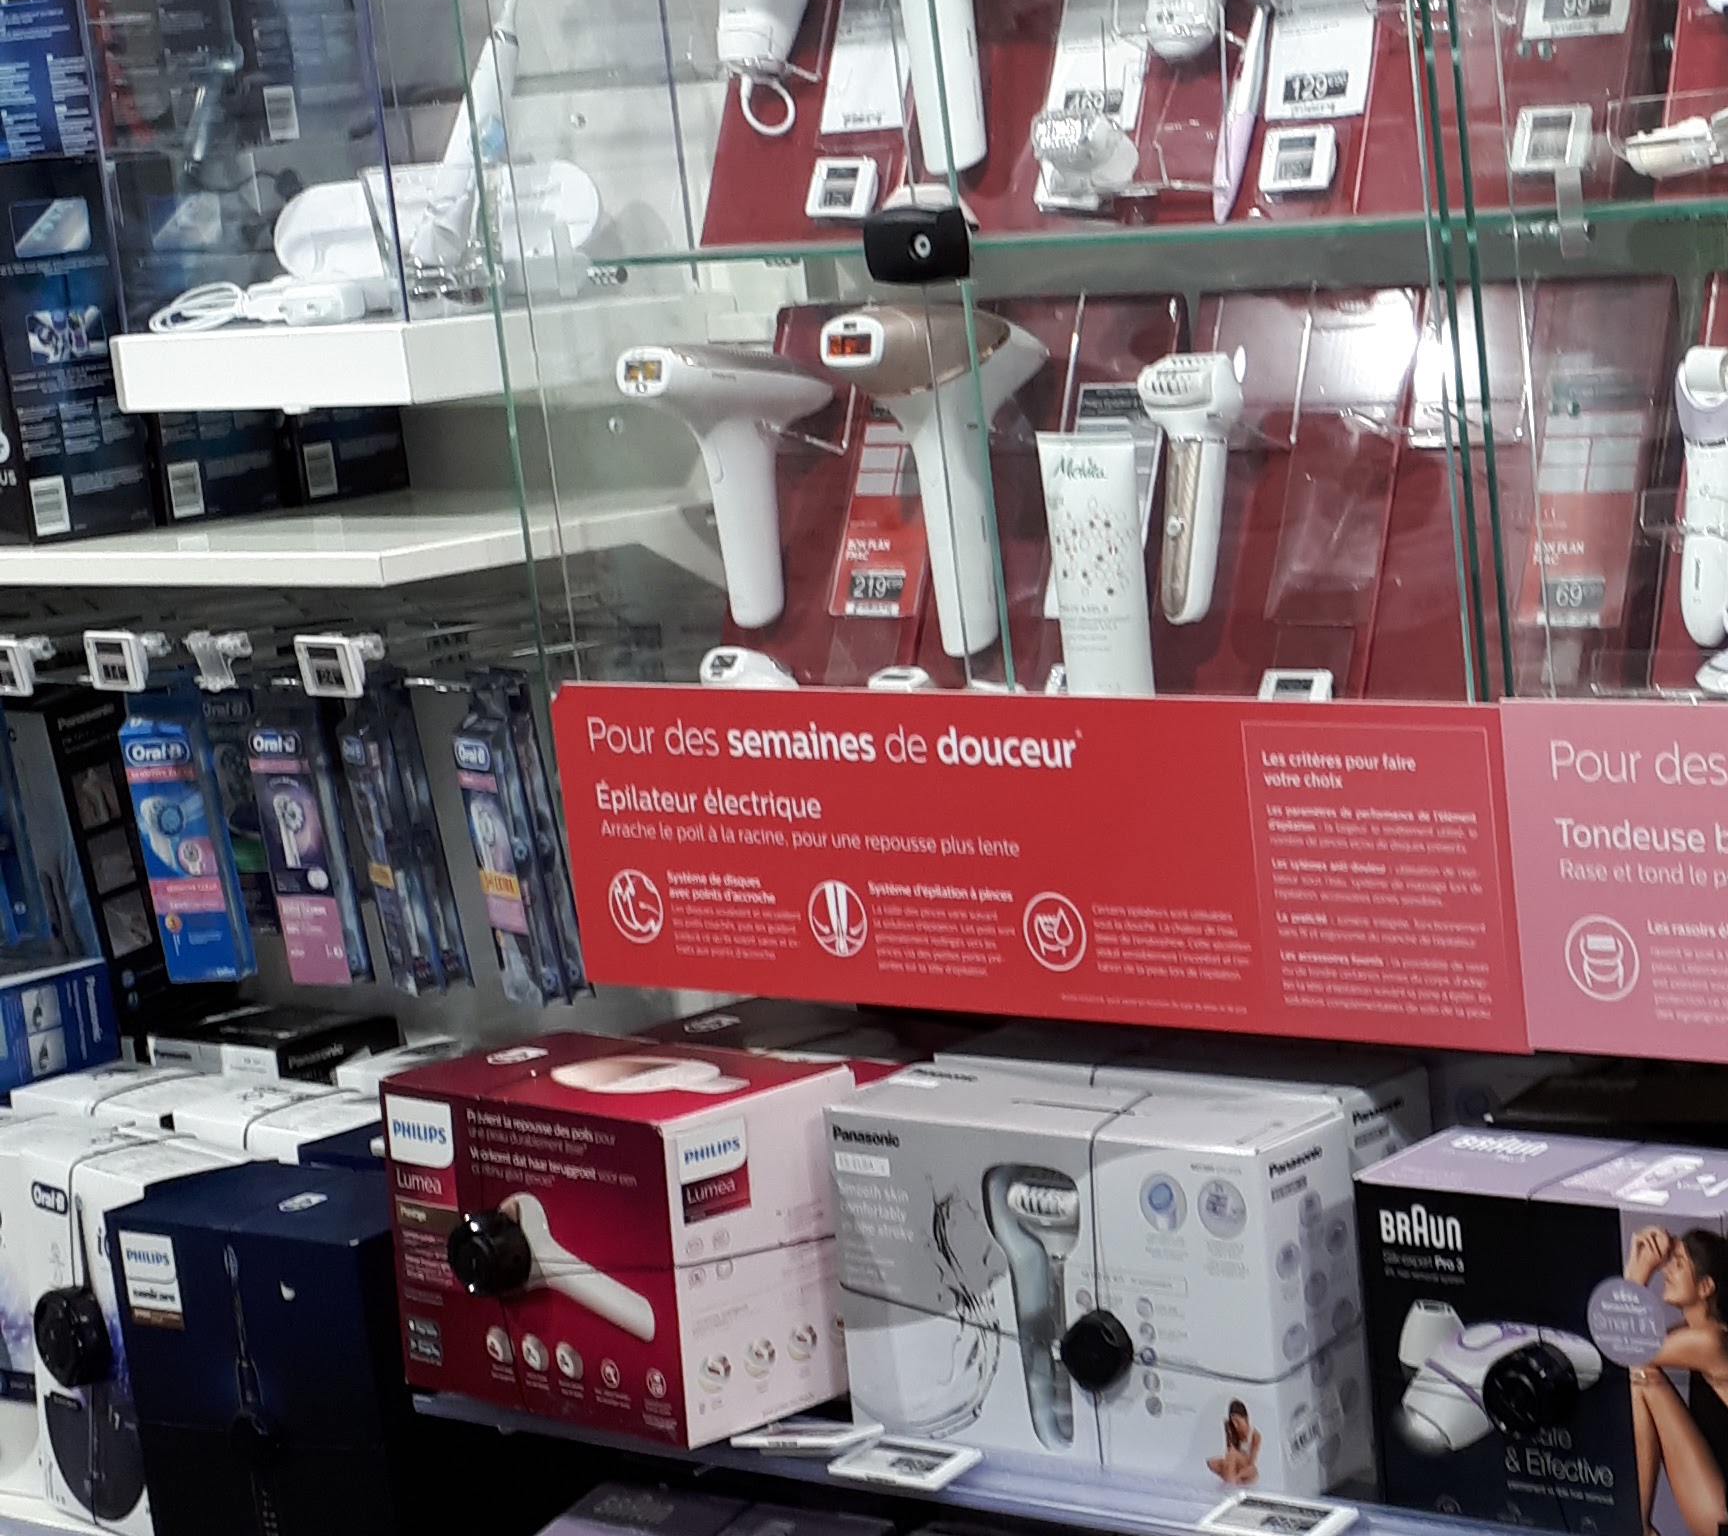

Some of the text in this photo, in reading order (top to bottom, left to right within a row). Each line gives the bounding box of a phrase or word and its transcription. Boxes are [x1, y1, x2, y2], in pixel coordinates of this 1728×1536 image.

[586, 715, 928, 764] Pour des semaines de
[1548, 738, 1642, 787] Pour
[1654, 741, 1728, 788] des
[595, 778, 822, 822] Épilateur électrique
[601, 818, 937, 856] Arrache repousse
[1554, 817, 1706, 855] Tondeuse
[1559, 859, 1608, 883] Rase
[1636, 861, 1684, 887] tond
[392, 1118, 447, 1145] PHILIPS
[832, 1124, 900, 1149] Panasonic
[683, 1136, 741, 1166] PHILIPS
[396, 1166, 443, 1196] Lumea
[685, 1177, 736, 1205] Lumea
[1379, 1203, 1463, 1253] BRAUN
[125, 1247, 172, 1267] PHILIPS
[1523, 1446, 1615, 1489] Effective
